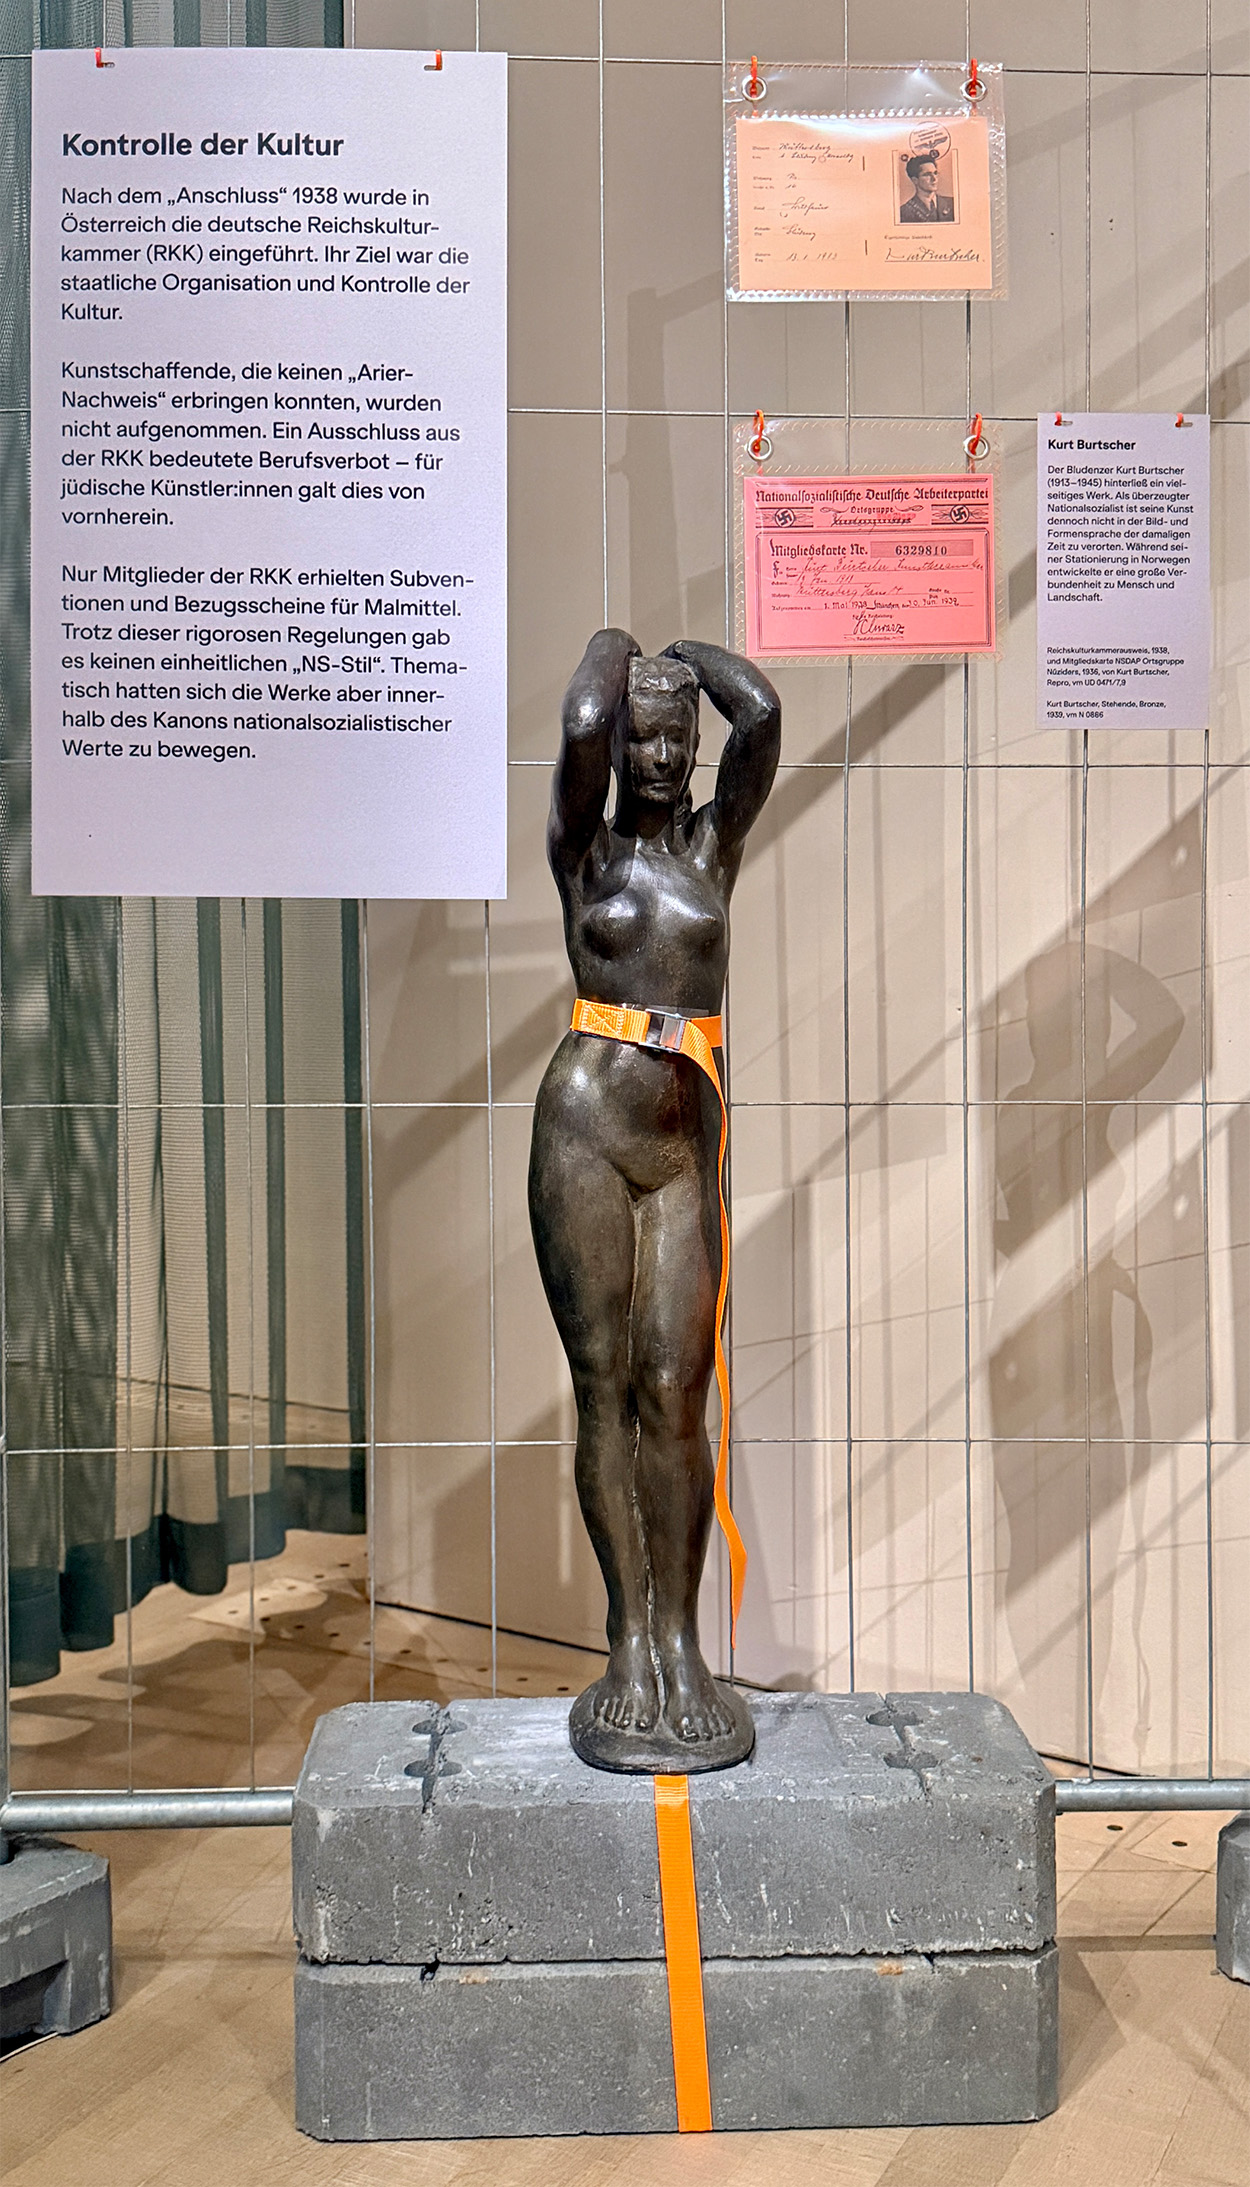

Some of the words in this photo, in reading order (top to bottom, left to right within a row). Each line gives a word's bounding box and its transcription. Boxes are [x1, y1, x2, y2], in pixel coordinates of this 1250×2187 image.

[63, 131, 192, 157] Kontrolle
[200, 132, 248, 156] der
[258, 132, 344, 156] Kultur
[62, 187, 112, 204] Nach
[118, 187, 161, 204] dem
[168, 186, 287, 207] „Anschluss“
[292, 187, 338, 204] 1938
[343, 188, 406, 205] wurde
[413, 189, 429, 205] in
[61, 213, 166, 234] Österreich
[172, 215, 202, 232] die
[208, 215, 301, 233] deutsche
[308, 216, 439, 234] Reichskultur-
[62, 245, 141, 262] kammer
[147, 243, 203, 265] (RKK)
[209, 244, 318, 267] eingeführt.
[325, 245, 350, 262] Ihr
[356, 246, 390, 263] Ziel
[396, 251, 433, 264] war
[438, 247, 468, 264] die
[61, 273, 156, 292] staatliche
[162, 273, 291, 296] Organisation
[298, 274, 334, 292] und
[342, 275, 430, 293] Kontrolle
[436, 276, 470, 293] der
[62, 303, 122, 320] Kultur.
[62, 360, 235, 382] Kunstschaffende,
[242, 362, 272, 380] die
[278, 363, 342, 380] keinen
[348, 364, 413, 384] „Arier-
[62, 390, 166, 409] Nachweis“
[172, 391, 268, 414] erbringen
[274, 392, 360, 413] konnten,
[366, 394, 441, 411] wurden
[62, 420, 111, 437] nicht
[117, 420, 266, 443] aufgenommen.
[273, 422, 302, 439] Ein
[307, 422, 420, 440] Ausschluss
[426, 428, 460, 441] aus
[1048, 439, 1074, 449] Kurt
[1077, 439, 1136, 450] Burtscher
[1048, 465, 1064, 474] Der
[1067, 465, 1114, 474] Bludenzer
[1116, 466, 1136, 474] Kurt
[1138, 466, 1184, 475] Burtscher
[1104, 479, 1148, 487] hinterließ
[1150, 479, 1164, 487] ein
[1166, 479, 1186, 488] viel-
[60, 478, 145, 500] jüdische
[152, 479, 292, 497] Künstler:innen
[298, 481, 336, 503] galt
[342, 481, 383, 499] dies
[388, 486, 424, 499] von
[914, 487, 989, 501] Arbeiterpartei
[1047, 491, 1084, 502] seitiges
[1086, 491, 1113, 500] Werk.
[1115, 491, 1130, 500] Als
[1132, 492, 1190, 502] überzeugter
[1048, 504, 1124, 513] Nationalsozialist
[1126, 504, 1138, 513] ist
[1140, 504, 1164, 513] seine
[1167, 504, 1194, 513] Kunst
[62, 507, 173, 525] vornherein.
[1047, 517, 1089, 525] dennoch
[1091, 517, 1114, 525] nicht
[1117, 517, 1125, 525] in
[1127, 517, 1144, 525] der
[1146, 517, 1168, 525] Bild-
[1170, 518, 1188, 526] und
[1048, 529, 1121, 540] Formensprache
[1124, 530, 1140, 538] der
[1142, 530, 1190, 540] damaligen
[895, 545, 947, 555] 6329810
[1047, 542, 1066, 551] Zeit
[1081, 543, 1124, 551] verorten.
[1126, 542, 1168, 551] Während
[1170, 543, 1188, 551] sei-
[1065, 555, 1128, 565] Stationierung
[1131, 555, 1139, 563] in
[1141, 555, 1190, 566] Norwegen
[62, 565, 98, 582] Nur
[104, 566, 205, 588] Mitglieder
[210, 567, 244, 584] der
[250, 568, 292, 585] RKK
[298, 568, 384, 586] erhielten
[390, 570, 474, 587] Subven-
[1047, 567, 1102, 576] entwickelte
[1116, 568, 1136, 576] eine
[1138, 567, 1165, 578] große
[1167, 568, 1187, 576] Ver-
[1048, 580, 1101, 589] bundenheit
[1117, 580, 1154, 589] Mensch
[1157, 581, 1174, 589] und
[1048, 593, 1102, 601] Landschaft.
[61, 594, 124, 611] tionen
[131, 595, 168, 612] und
[175, 596, 325, 618] Bezugsscheine
[330, 598, 359, 615] für
[365, 599, 461, 616] Malmittel.
[61, 623, 112, 640] Trotz
[118, 624, 180, 641] dieser
[186, 625, 281, 647] rigorosen
[288, 626, 406, 649] Regelungen
[412, 628, 450, 649] gab
[62, 656, 84, 669] es
[91, 652, 154, 670] keinen
[161, 654, 287, 671] einheitlichen
[293, 655, 385, 675] „NS-Stil“.
[390, 657, 467, 674] Thema-
[1062, 658, 1113, 666] Mitgliedskarte
[1142, 657, 1184, 666] Ortsgruppe
[1134, 668, 1169, 676] Burtscher,
[1047, 679, 1070, 687] Repro,
[1139, 700, 1166, 708] Bronze,
[63, 710, 105, 727] halb
[110, 711, 147, 728] des
[154, 712, 228, 729] Kanons
[234, 713, 452, 732] nationalsozialistischer
[1047, 711, 1064, 719] 1939,
[62, 739, 123, 756] Werte
[129, 745, 151, 757] zu
[158, 741, 256, 763] bewegen.
